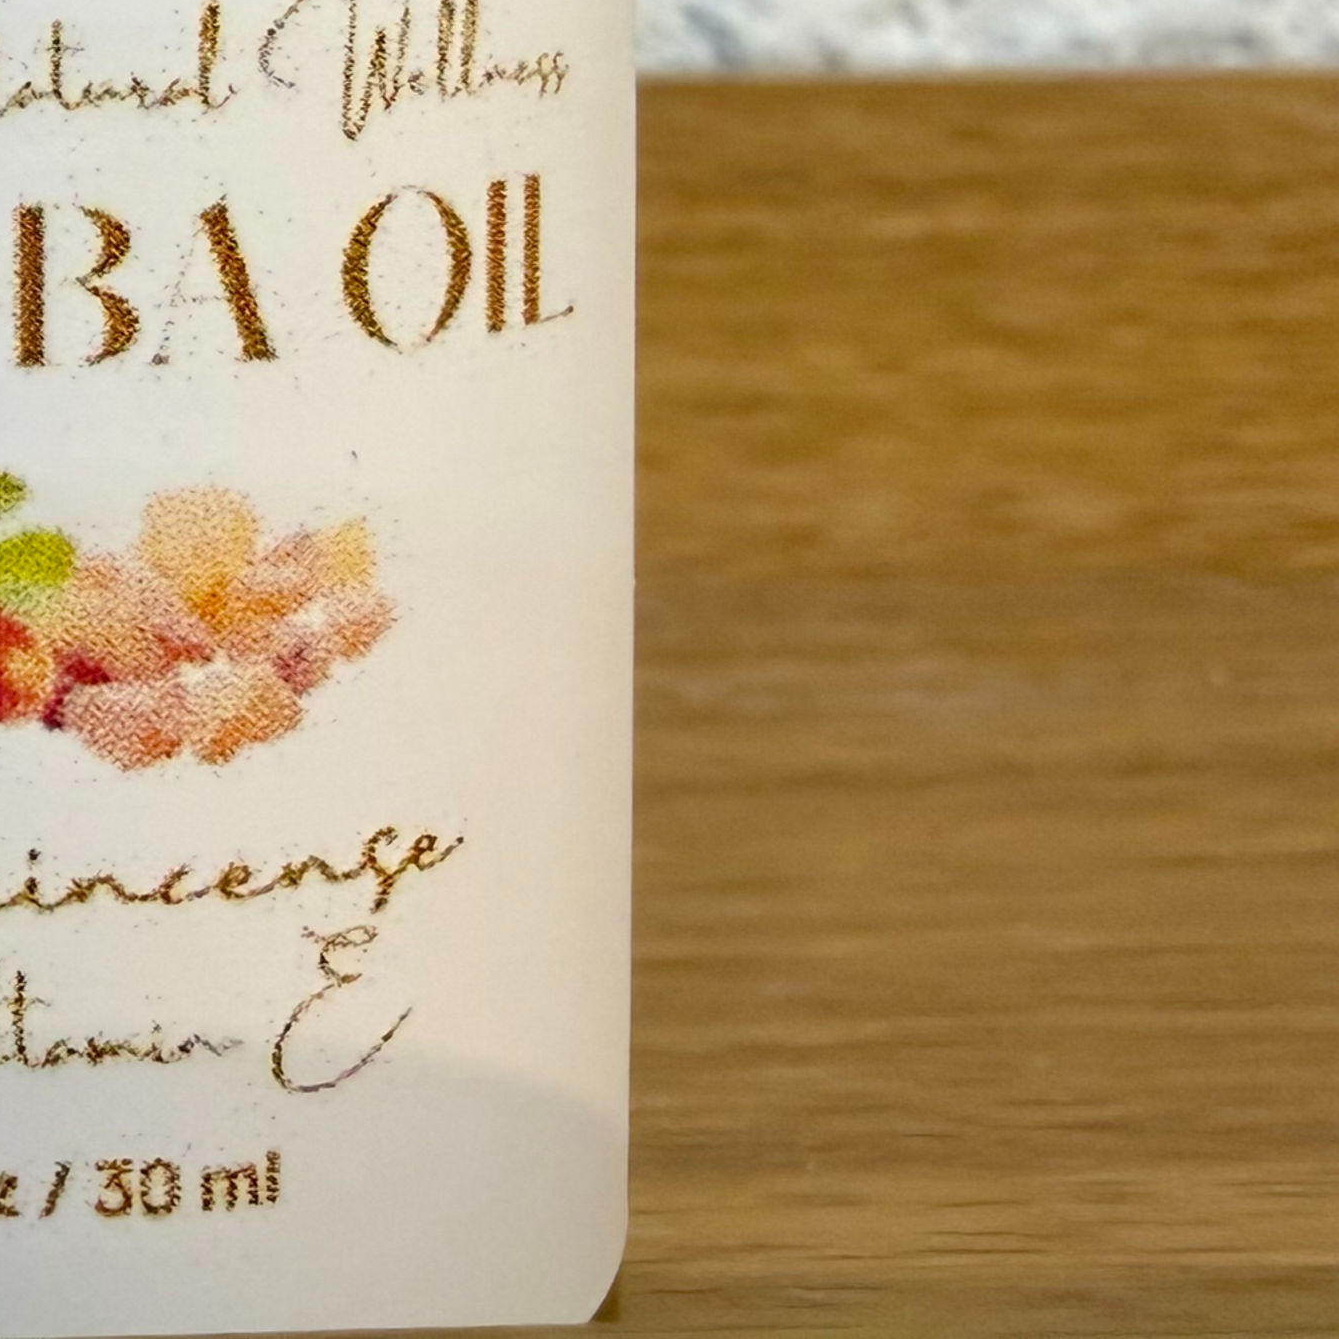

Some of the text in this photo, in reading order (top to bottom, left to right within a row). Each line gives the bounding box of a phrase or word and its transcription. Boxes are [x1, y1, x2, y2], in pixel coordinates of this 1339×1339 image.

[338, 171, 575, 354] OIL
[268, 924, 413, 1095] E
[39, 1160, 70, 1219] /
[93, 1157, 182, 1217] 30
[200, 1150, 282, 1213] ml
